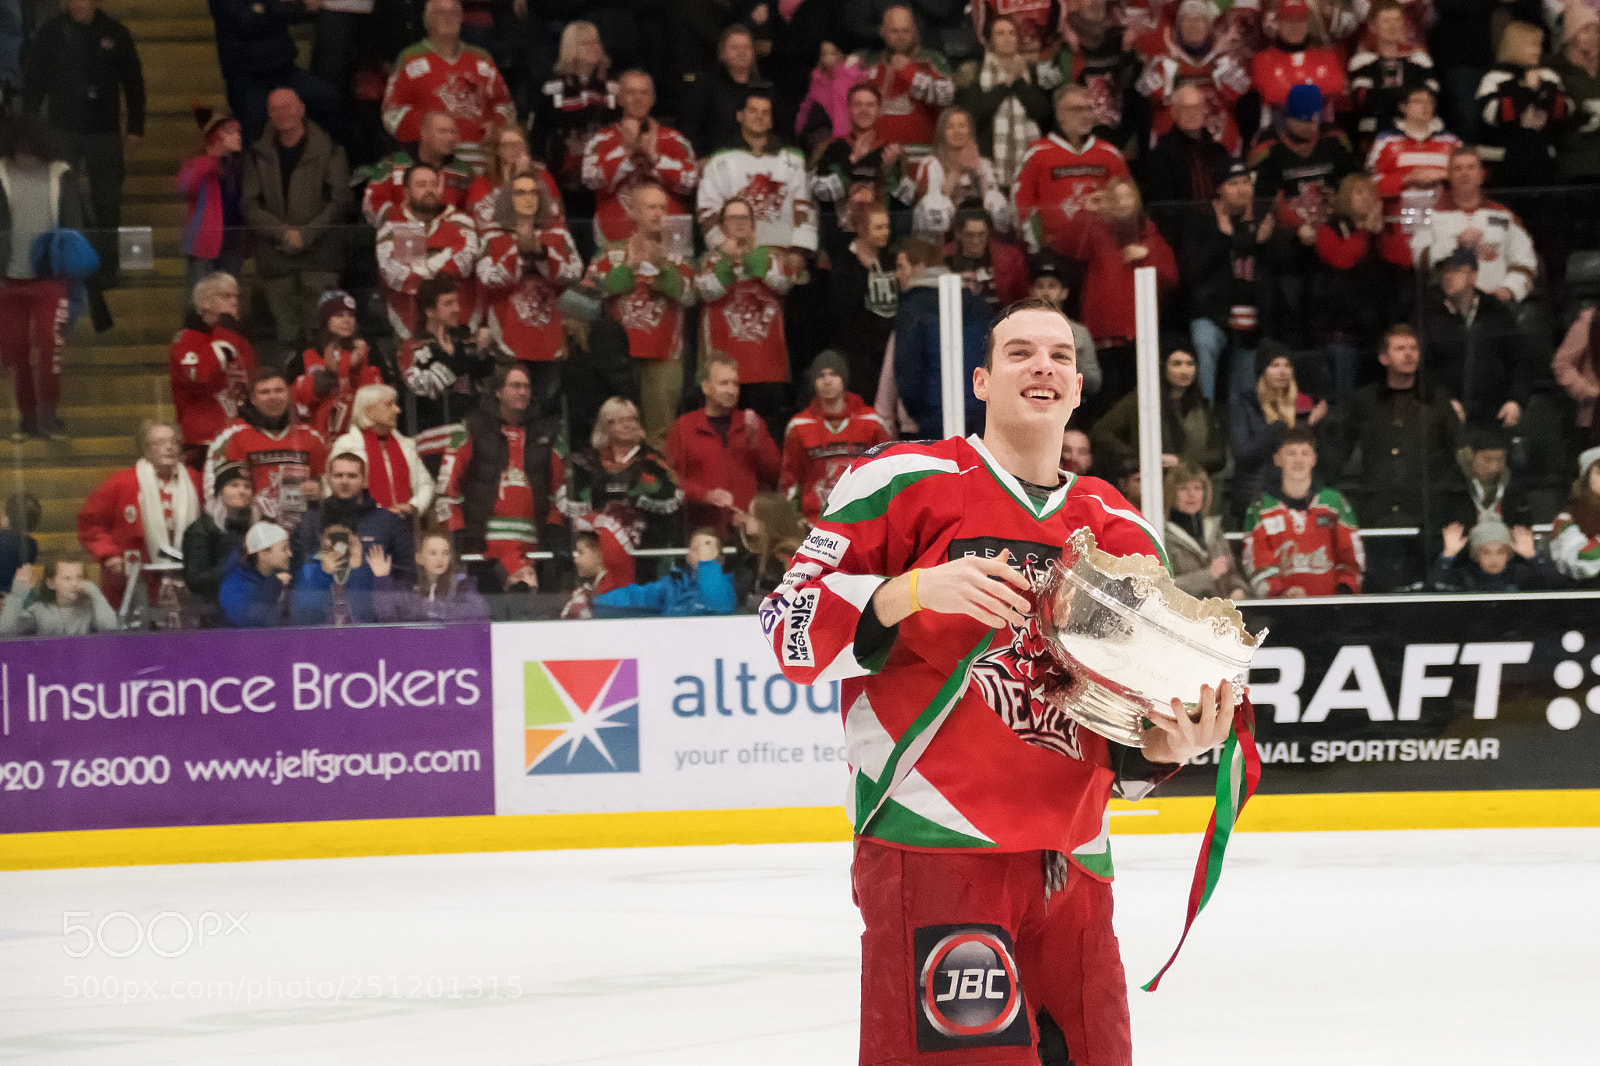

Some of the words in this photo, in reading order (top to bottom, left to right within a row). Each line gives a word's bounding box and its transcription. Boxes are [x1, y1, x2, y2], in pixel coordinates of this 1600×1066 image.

[787, 595, 807, 661] MANIC
[797, 594, 815, 661] MECHANICS
[27, 673, 276, 723] Insurance
[292, 658, 481, 712] Brokers
[0, 760, 45, 792] 20
[51, 754, 171, 789] 768000
[185, 748, 480, 785] www.jelfgroup.com
[675, 747, 728, 771] your
[737, 743, 804, 765] office
[1311, 737, 1500, 764] SPORTSWEAR
[936, 968, 1006, 1002] JBC
